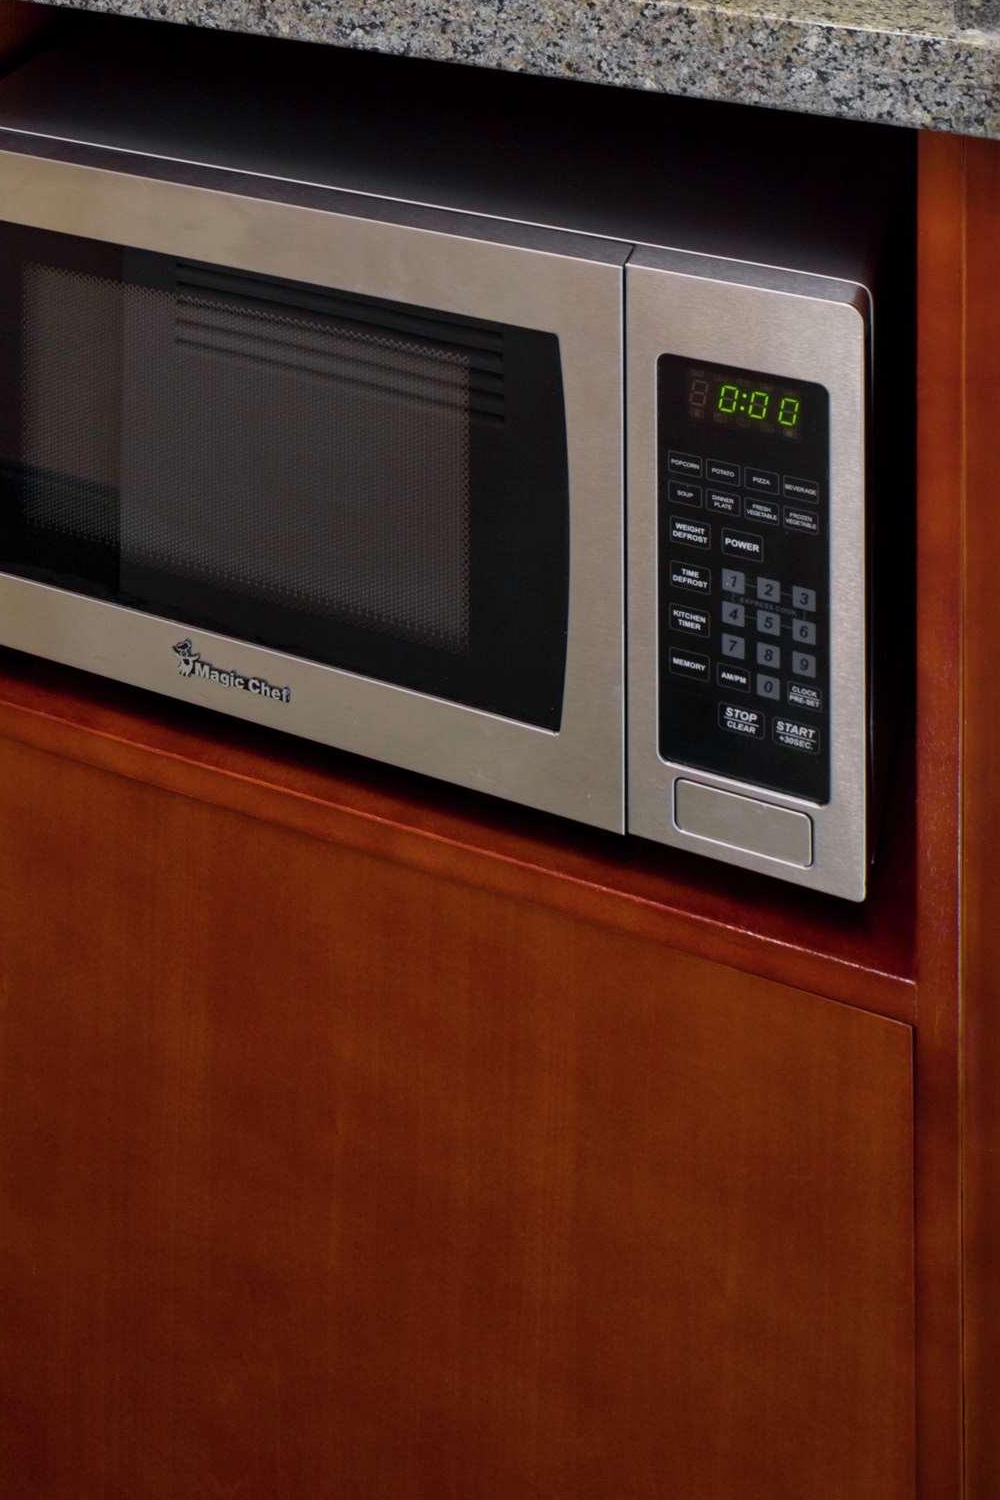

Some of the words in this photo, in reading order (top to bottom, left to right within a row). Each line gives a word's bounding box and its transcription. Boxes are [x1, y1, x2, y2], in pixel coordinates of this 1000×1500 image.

[670, 458, 700, 470] POPCORN
[711, 467, 735, 478] POTATO
[752, 476, 771, 486] PIZZA
[676, 489, 694, 499] SOUP
[784, 483, 817, 496] BEVERAGE
[713, 501, 732, 511] PLATE
[675, 522, 705, 536] WEIGHT
[672, 530, 708, 544] DEFROST
[725, 537, 760, 553] POWER
[681, 568, 700, 579] TIME
[672, 574, 708, 588] DEFROST
[730, 575, 737, 587] 1
[764, 583, 774, 597] 2
[799, 592, 809, 606] 3
[673, 609, 706, 623] KITCHEN
[728, 608, 739, 621] 4
[677, 619, 702, 631] TIMER
[763, 616, 773, 630] 5
[799, 625, 809, 639] 6
[728, 640, 738, 652] 7
[764, 649, 773, 663] 8
[672, 657, 706, 672] MEMORY
[800, 658, 809, 672] 9
[194, 660, 246, 688] Magic
[247, 678, 291, 703] Chef
[764, 680, 773, 693] 0
[791, 686, 818, 698] CLOCK
[725, 706, 758, 723] STOP
[726, 720, 756, 735] CLEAR
[776, 720, 816, 739] START
